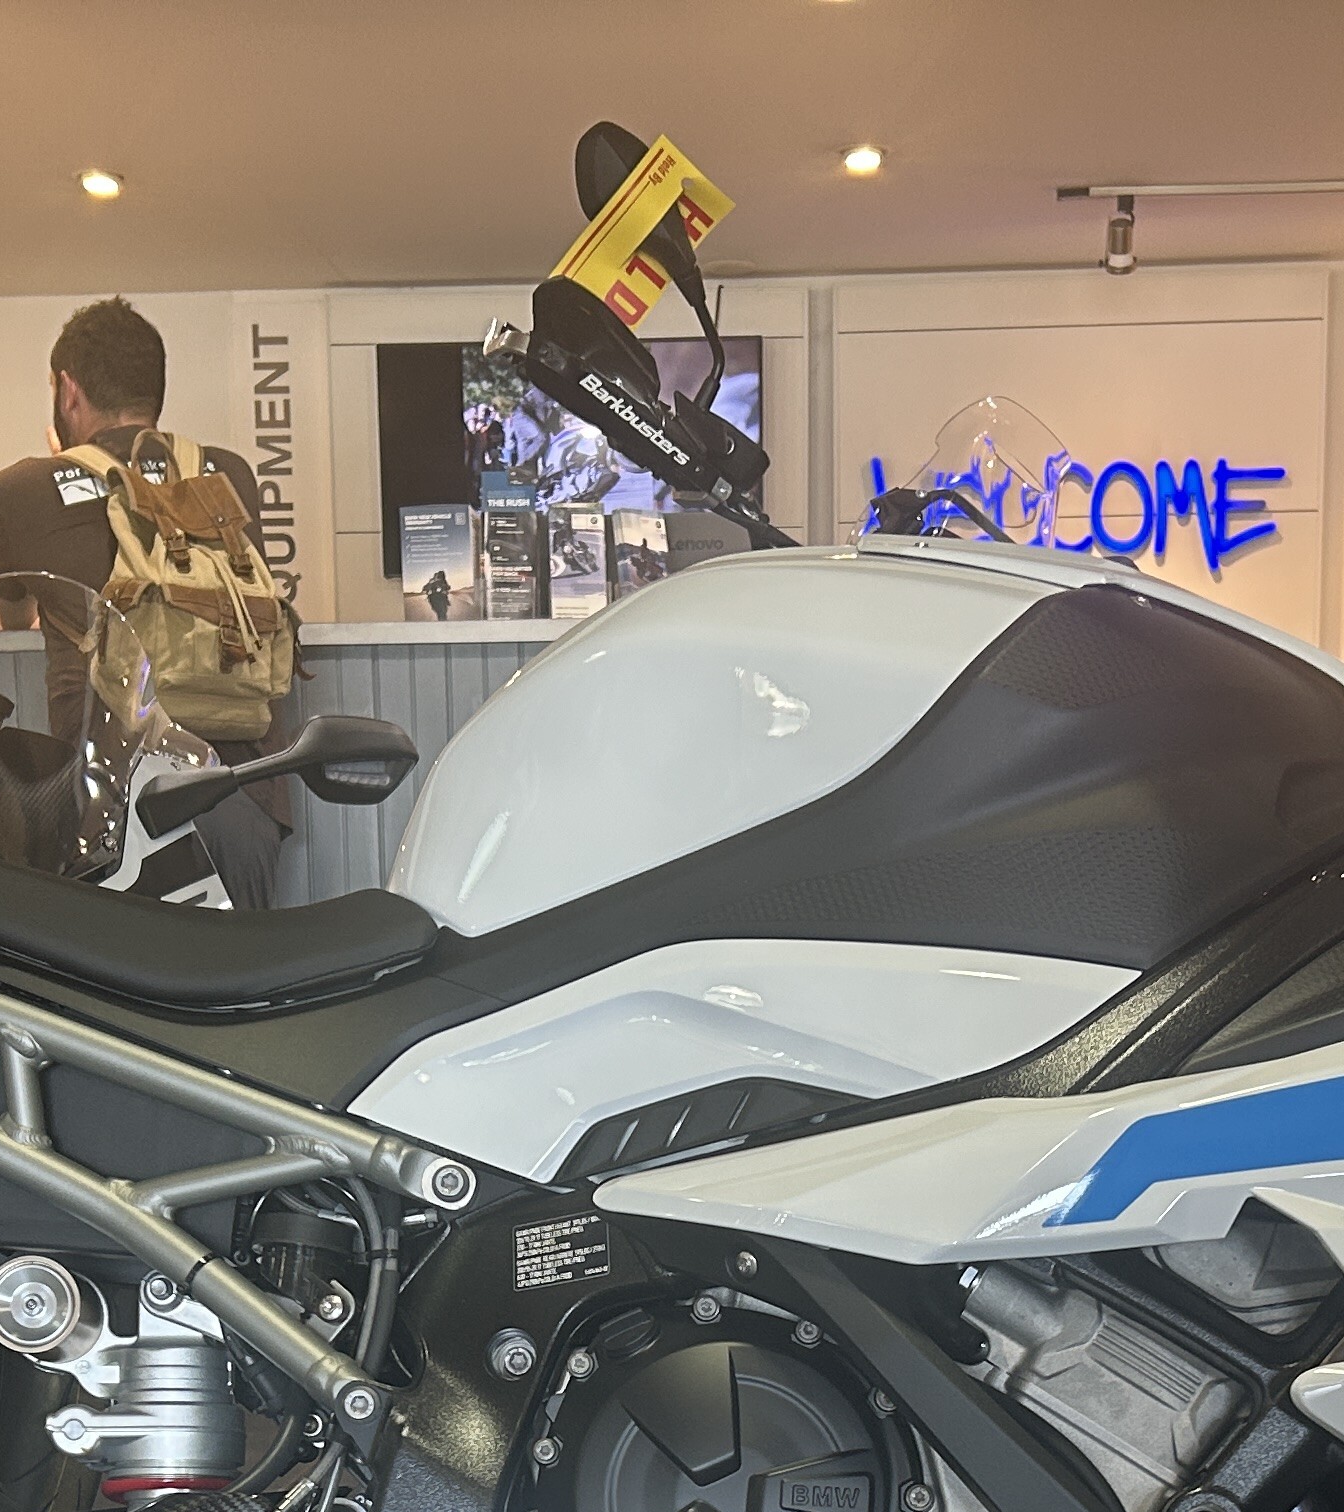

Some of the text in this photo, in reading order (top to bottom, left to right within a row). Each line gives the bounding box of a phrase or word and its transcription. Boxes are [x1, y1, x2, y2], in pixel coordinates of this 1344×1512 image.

[252, 324, 301, 603] QUIPMENT
[579, 374, 690, 465] Barkbusters
[791, 1484, 860, 1509] BMW
